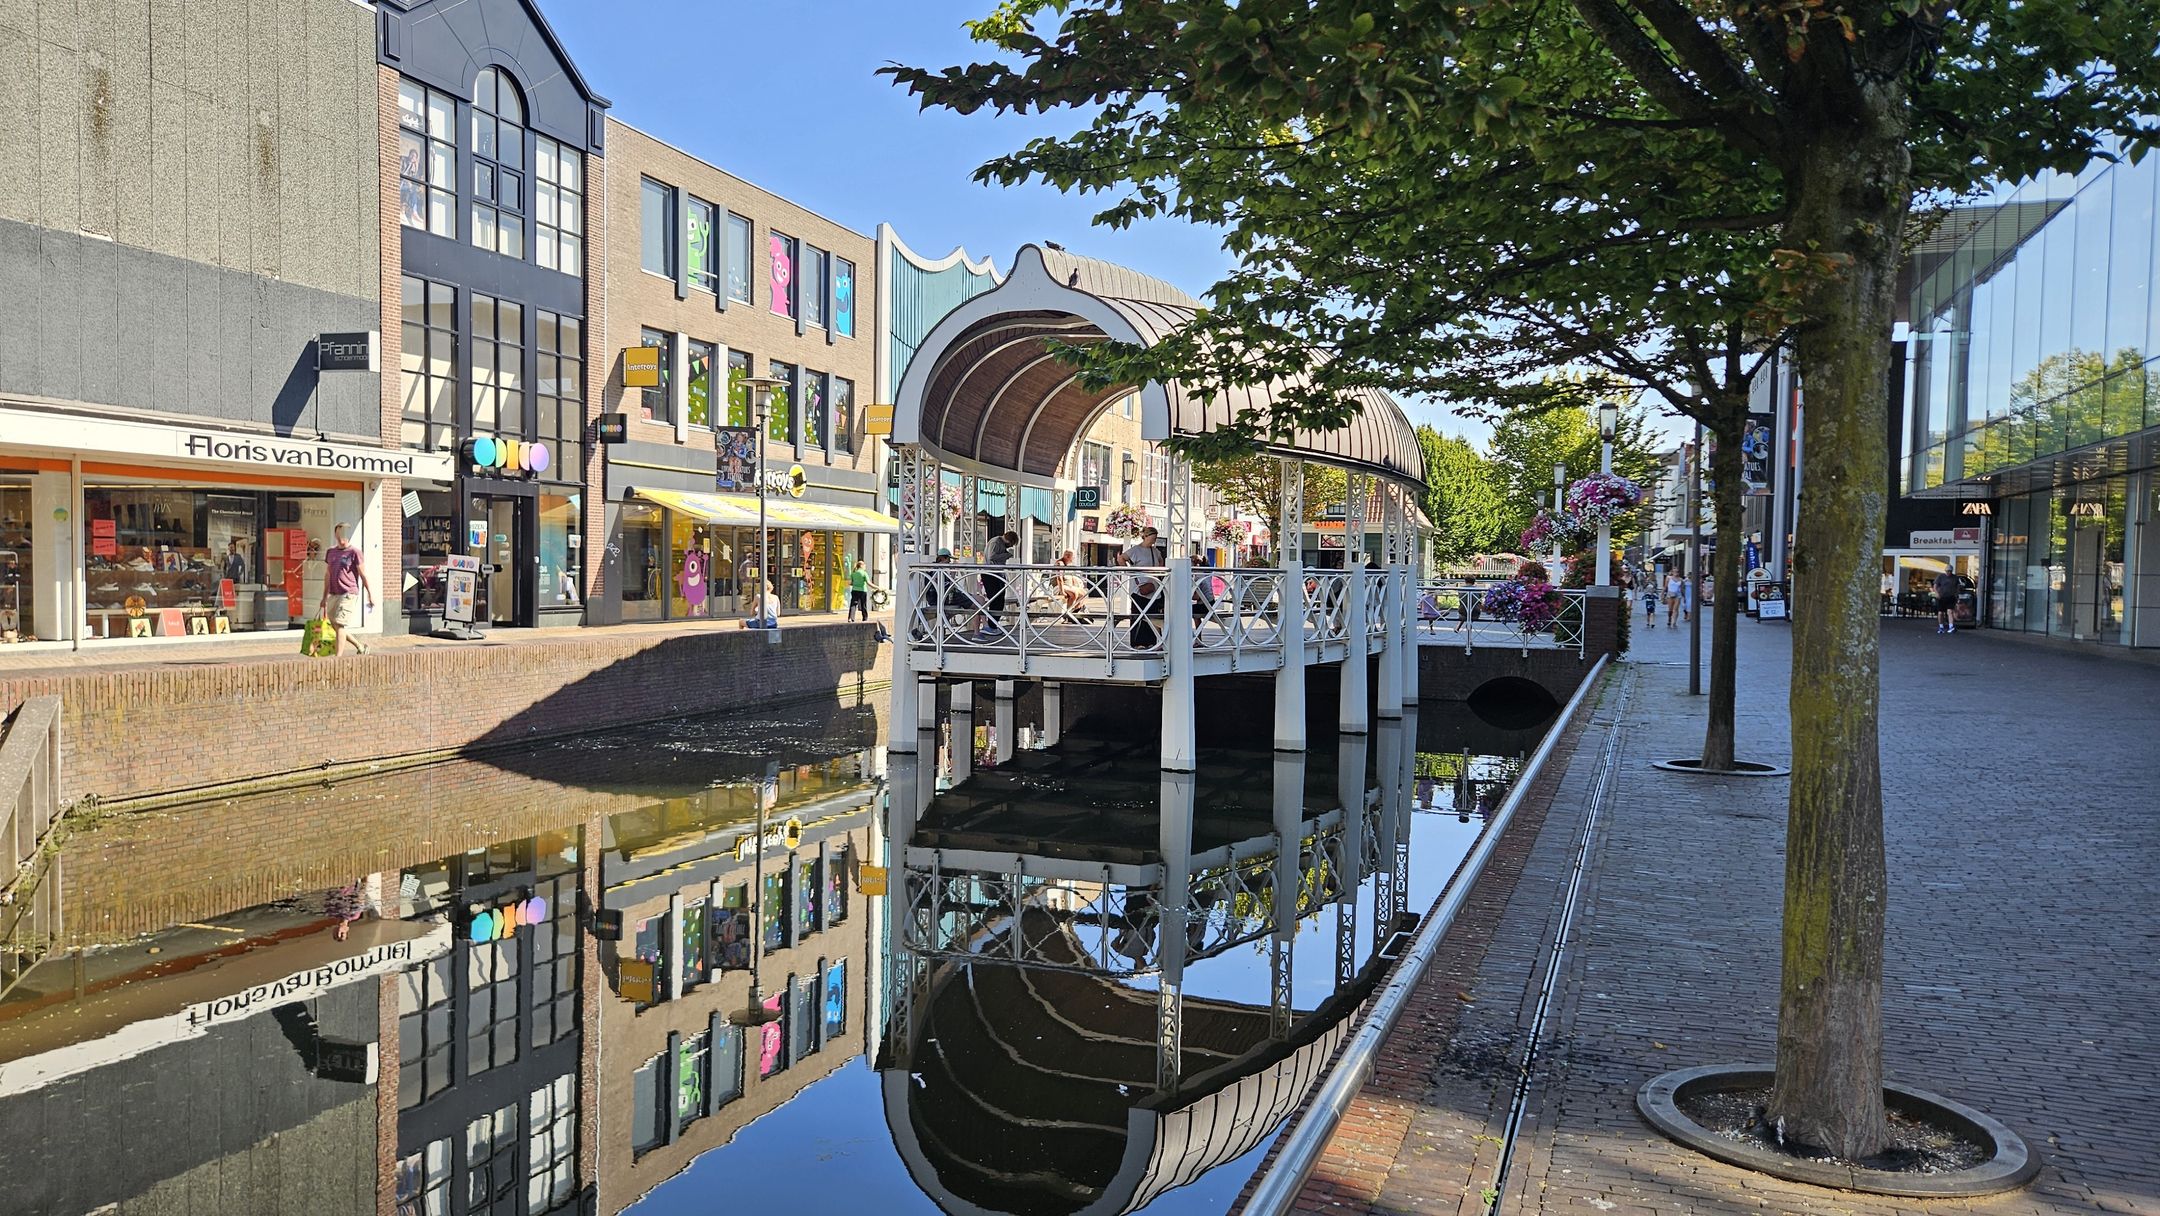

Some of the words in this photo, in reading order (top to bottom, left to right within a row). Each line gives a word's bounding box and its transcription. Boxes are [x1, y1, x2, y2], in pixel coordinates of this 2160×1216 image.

[185, 434, 268, 461] Floris
[271, 447, 312, 466] van
[316, 447, 413, 475] Bommel
[1962, 502, 1992, 515] ZARA
